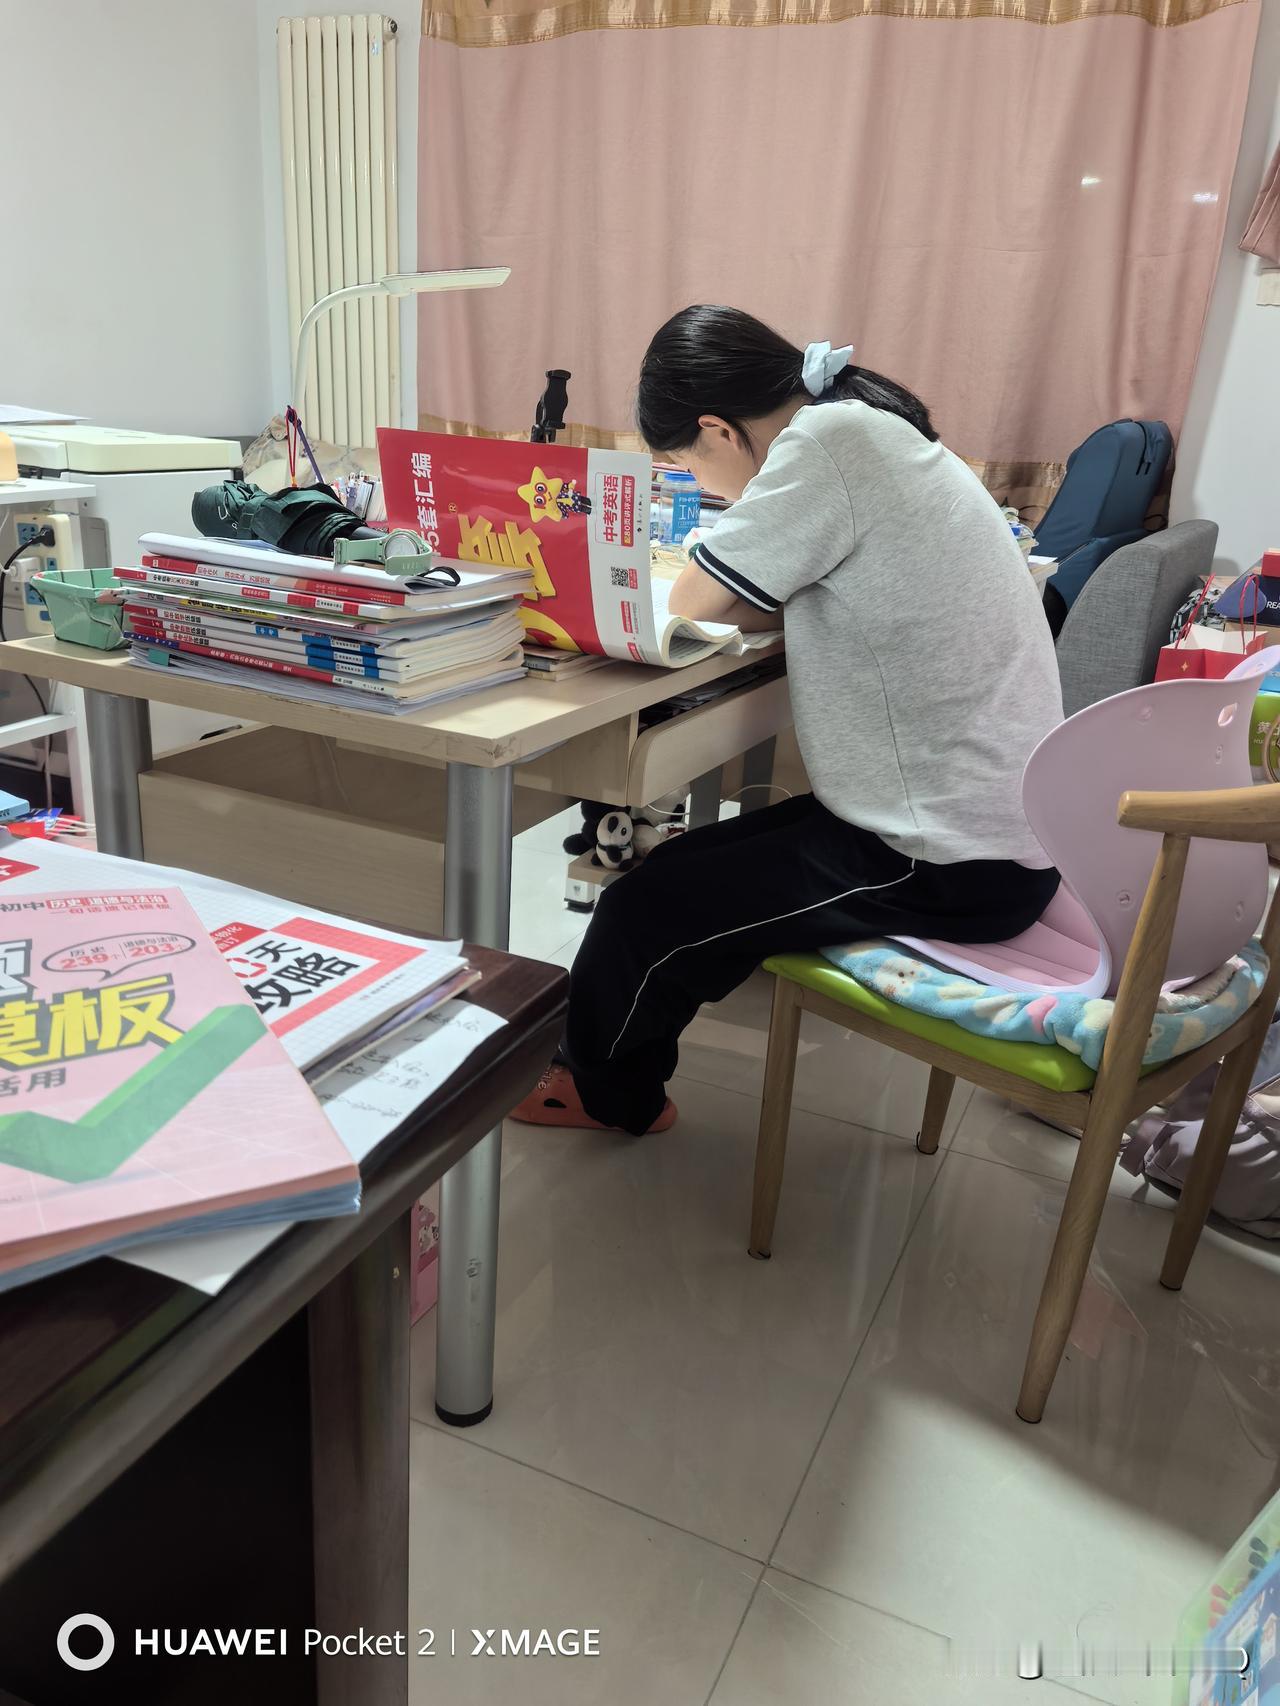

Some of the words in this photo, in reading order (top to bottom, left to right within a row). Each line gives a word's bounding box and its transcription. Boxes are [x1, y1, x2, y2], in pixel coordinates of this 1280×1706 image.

[411, 452, 441, 557] 5套汇编
[603, 475, 619, 542] 中考英语
[0, 901, 45, 912] 初中
[50, 898, 82, 909] 历史
[244, 952, 360, 1014] 攻略
